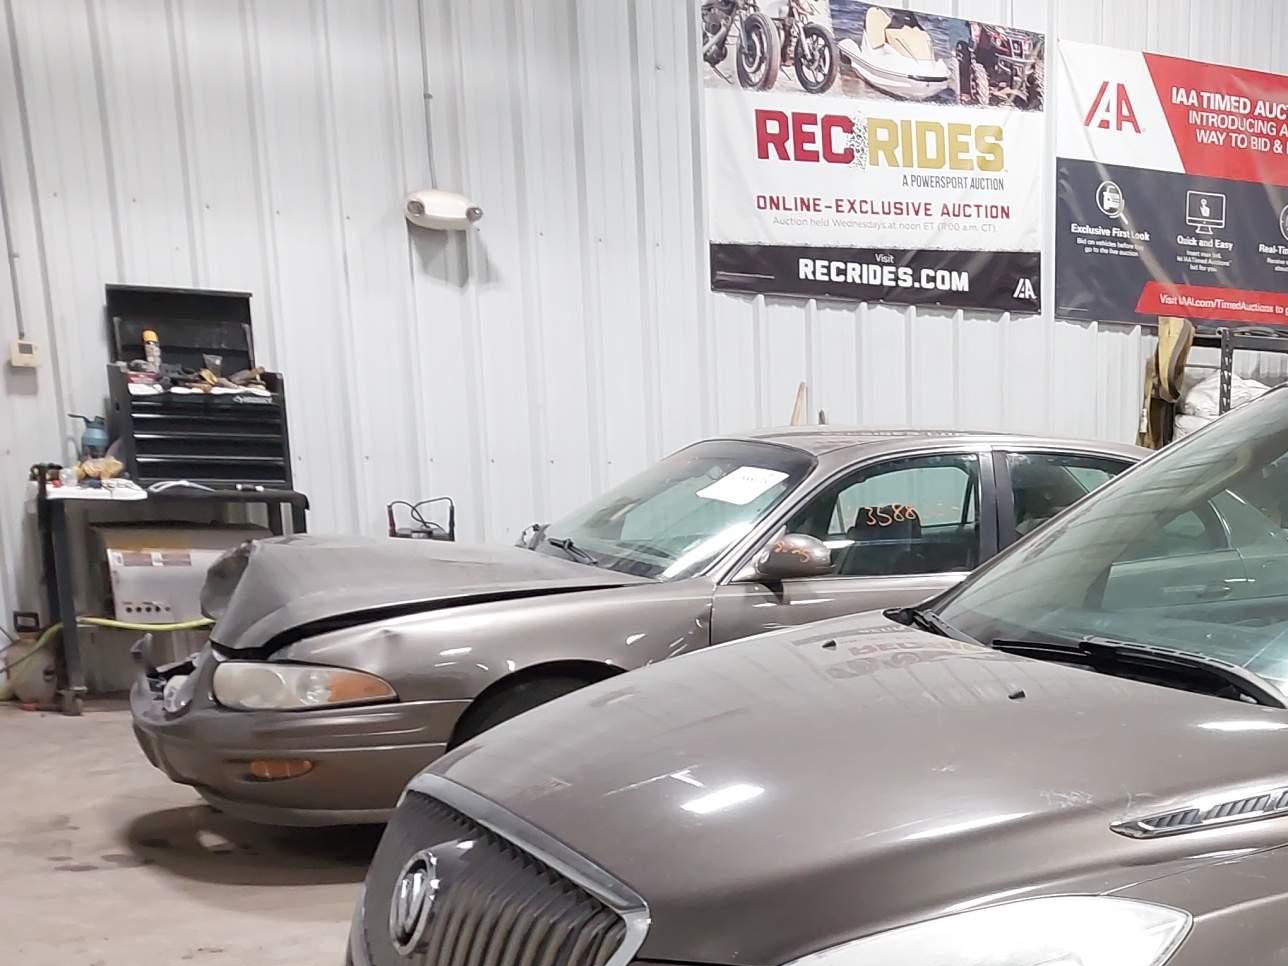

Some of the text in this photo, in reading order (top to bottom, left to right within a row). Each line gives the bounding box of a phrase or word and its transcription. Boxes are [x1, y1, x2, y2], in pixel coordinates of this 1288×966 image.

[1172, 86, 1199, 107] IAA
[1200, 92, 1251, 115] TIMED
[1188, 110, 1277, 136] INTRODUCING
[755, 109, 1005, 173] REC RIDES
[1196, 129, 1227, 146] WAY
[1229, 133, 1248, 149] TO
[1251, 136, 1271, 152] BID
[1273, 139, 1284, 154] &
[902, 174, 1005, 191] A POWERSPORT AUCTION
[756, 195, 1011, 219] ONLINE-EXCLUSIVE AUCTION
[772, 217, 809, 226] Auction
[898, 222, 921, 230] noon
[1071, 223, 1150, 241] Exclusive First Look
[1177, 235, 1234, 251] Quick and Easy
[875, 253, 895, 264] Visit
[799, 258, 969, 292] RECRIDES.COM
[1159, 293, 1178, 305] Visit
[1275, 305, 1285, 314] to
[864, 502, 918, 526] 3588
